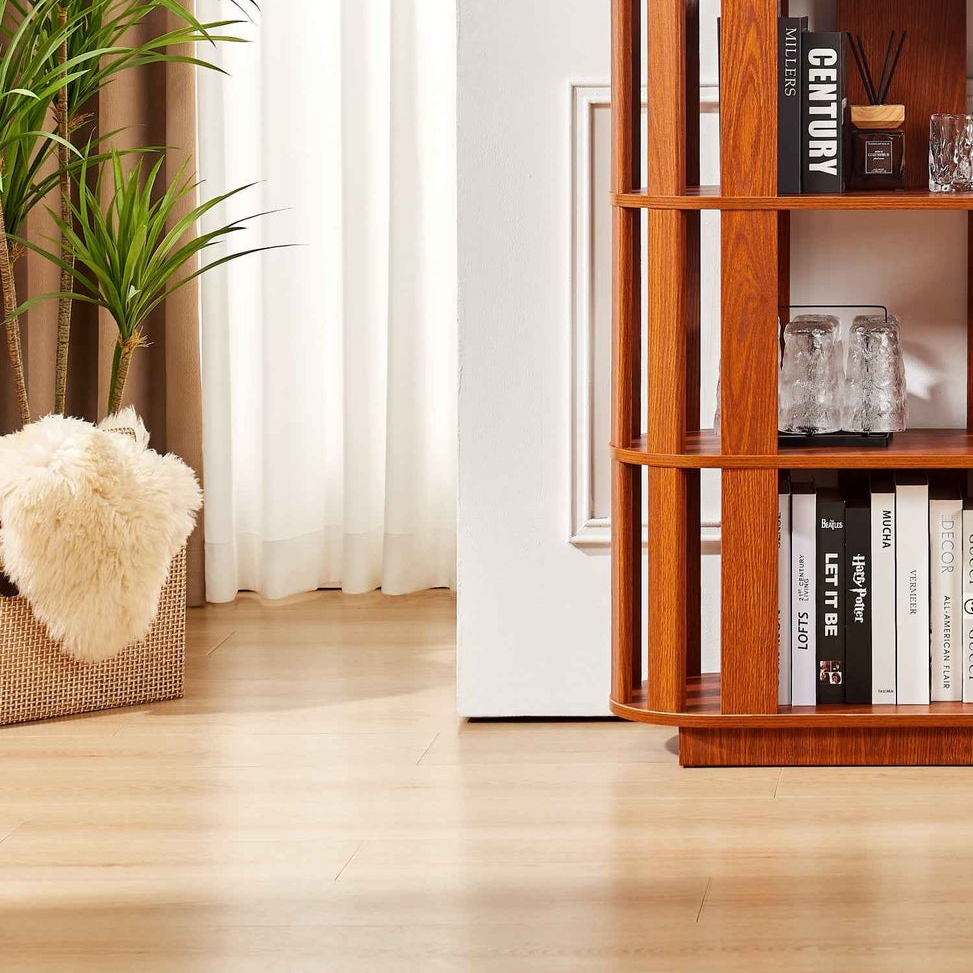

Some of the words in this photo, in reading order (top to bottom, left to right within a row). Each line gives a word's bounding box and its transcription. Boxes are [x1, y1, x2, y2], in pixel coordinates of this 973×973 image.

[784, 27, 797, 97] MILLERS
[808, 48, 838, 176] CENTURY
[882, 510, 892, 549] MUCHA
[941, 520, 955, 574] DECOR
[825, 553, 838, 587] LET
[825, 591, 838, 608] IT
[849, 587, 867, 623] Potter
[909, 569, 917, 615] VERMEER
[797, 612, 809, 650] LOFTS
[824, 612, 838, 636] BE
[943, 595, 951, 662] ALL-AMERICAN
[942, 665, 951, 689] FLAIR
